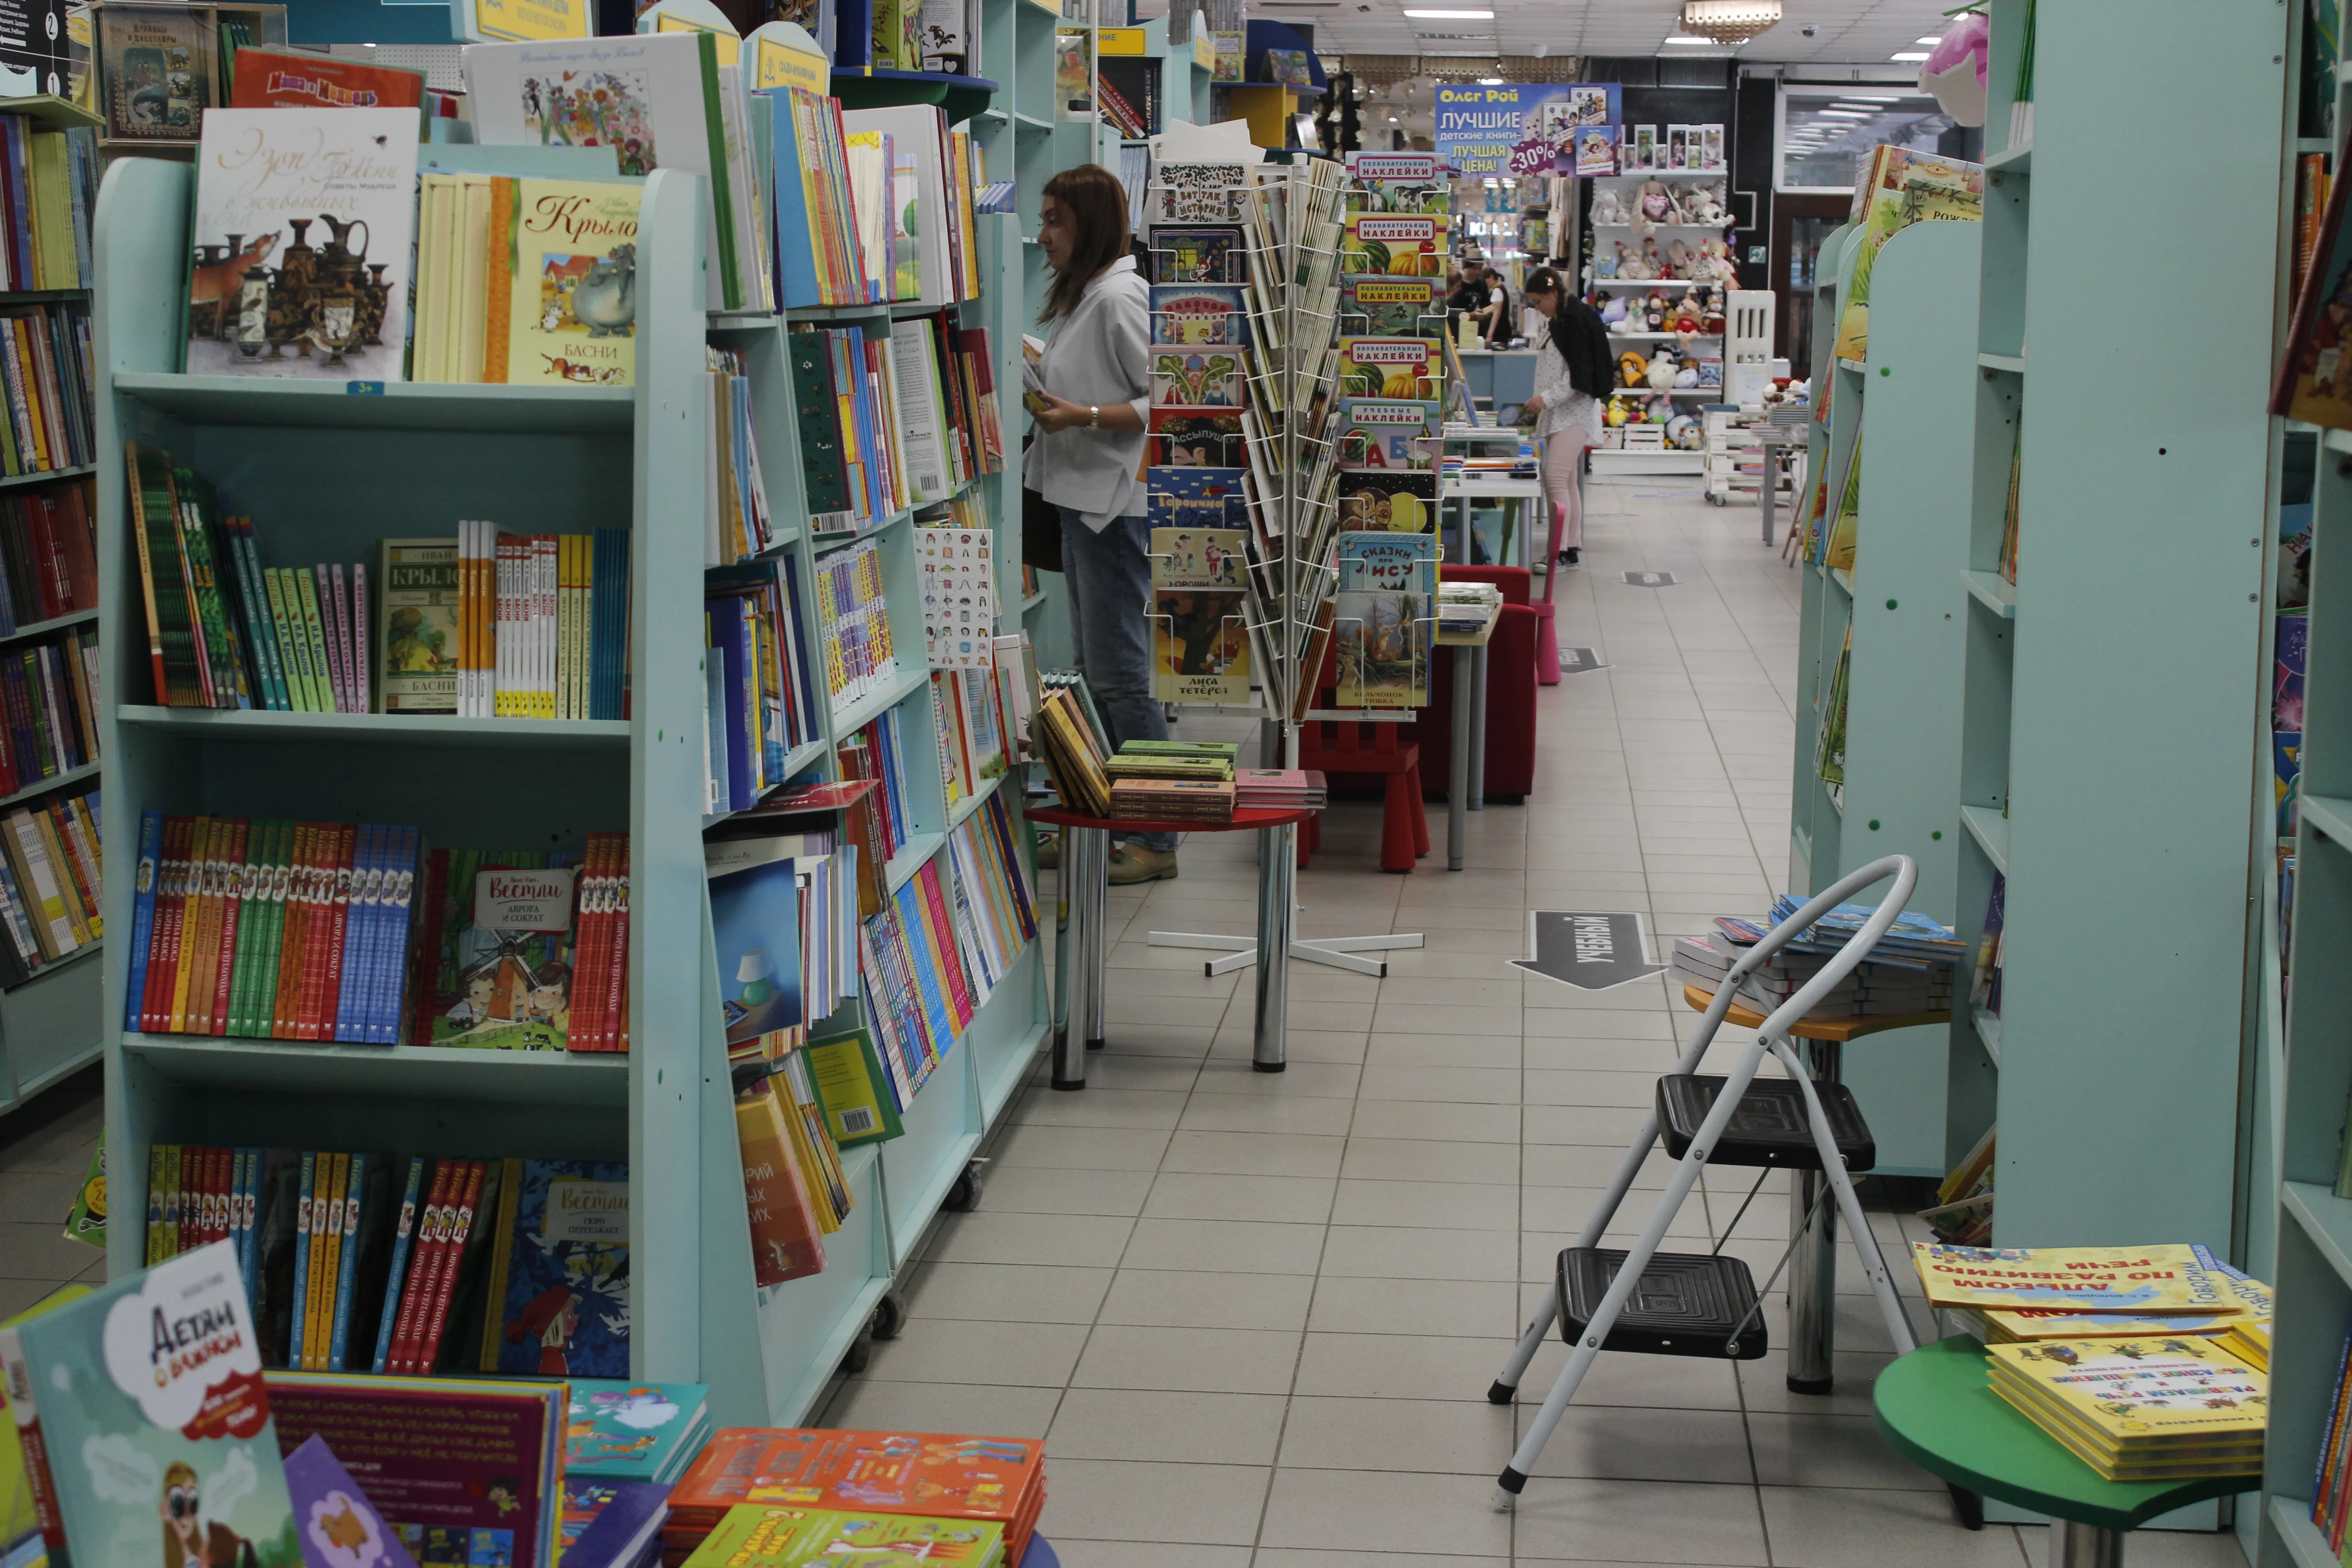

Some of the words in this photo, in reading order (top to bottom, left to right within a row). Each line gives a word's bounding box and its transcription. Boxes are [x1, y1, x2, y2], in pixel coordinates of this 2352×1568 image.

[49, 15, 55, 34] 2
[1113, 92, 1133, 114] СКАЗКИ
[1440, 90, 1481, 103] Олег
[1485, 88, 1519, 102] Рой
[1117, 107, 1135, 127] СКАЗКИ
[1440, 112, 1520, 129] ЛУЧШИЕ
[1453, 146, 1505, 157] ЛУЧШАЯ
[1510, 142, 1555, 170] -30%
[1462, 160, 1497, 172] ЦЕНА!
[1181, 191, 1198, 201] ВОТ
[1201, 191, 1221, 201] ТАК
[1180, 203, 1225, 217] ИСТОРИЯ!
[525, 195, 637, 244] Крыло
[1363, 229, 1429, 237] НАКЛЕЙКИ
[565, 343, 617, 359] БАСНИ
[1366, 444, 1387, 467] А
[422, 550, 452, 559] ИВАН
[1362, 547, 1412, 559] СКАЗКИ
[392, 568, 459, 585] КРЫЛО
[1356, 563, 1413, 577] ЛИСУ
[283, 642, 295, 675] Крылов
[298, 642, 310, 676] Крылов
[314, 643, 326, 677] Крылов
[413, 681, 455, 690] БАСНИ
[490, 877, 563, 899] Вестли
[163, 908, 173, 934] ТАЙНА
[173, 909, 183, 935] ТАЙНА
[225, 907, 235, 935] АВРОРА
[223, 937, 232, 948] НА
[1563, 916, 1614, 963] УЧЕБНЫЙ
[329, 946, 340, 980] СОКРАТ
[616, 949, 622, 960] НА
[219, 949, 231, 998] ТЕПЛОХОДЕ
[609, 961, 622, 1012] ТЕПЛОХОДЕ
[412, 1250, 426, 1278] АВРОРА
[428, 1250, 441, 1279] АВРОРА
[444, 1251, 458, 1279] АВРОРА
[1933, 1264, 2117, 1280] РАЗВИТИЮ
[2065, 1259, 2151, 1270] РЕЧИ
[409, 1279, 418, 1290] НА
[424, 1280, 434, 1291] НА
[441, 1281, 450, 1292] НА
[1953, 1279, 2108, 1290] АЛЬБОМ
[2182, 1261, 2220, 1304] Говорим
[397, 1292, 416, 1340] ТЕПЛОХОДЕ
[412, 1293, 431, 1341] ТЕПЛОХОДЕ
[428, 1294, 447, 1342] ТЕПЛОХОДЕ
[2047, 1372, 2156, 1383] МЫШЛЕНИЕ
[2161, 1367, 2248, 1378] ОБРАЗНОЕ
[2096, 1390, 2144, 1400] РЕЧЬ
[2145, 1386, 2258, 1398] РАЗВИВАЕМ
